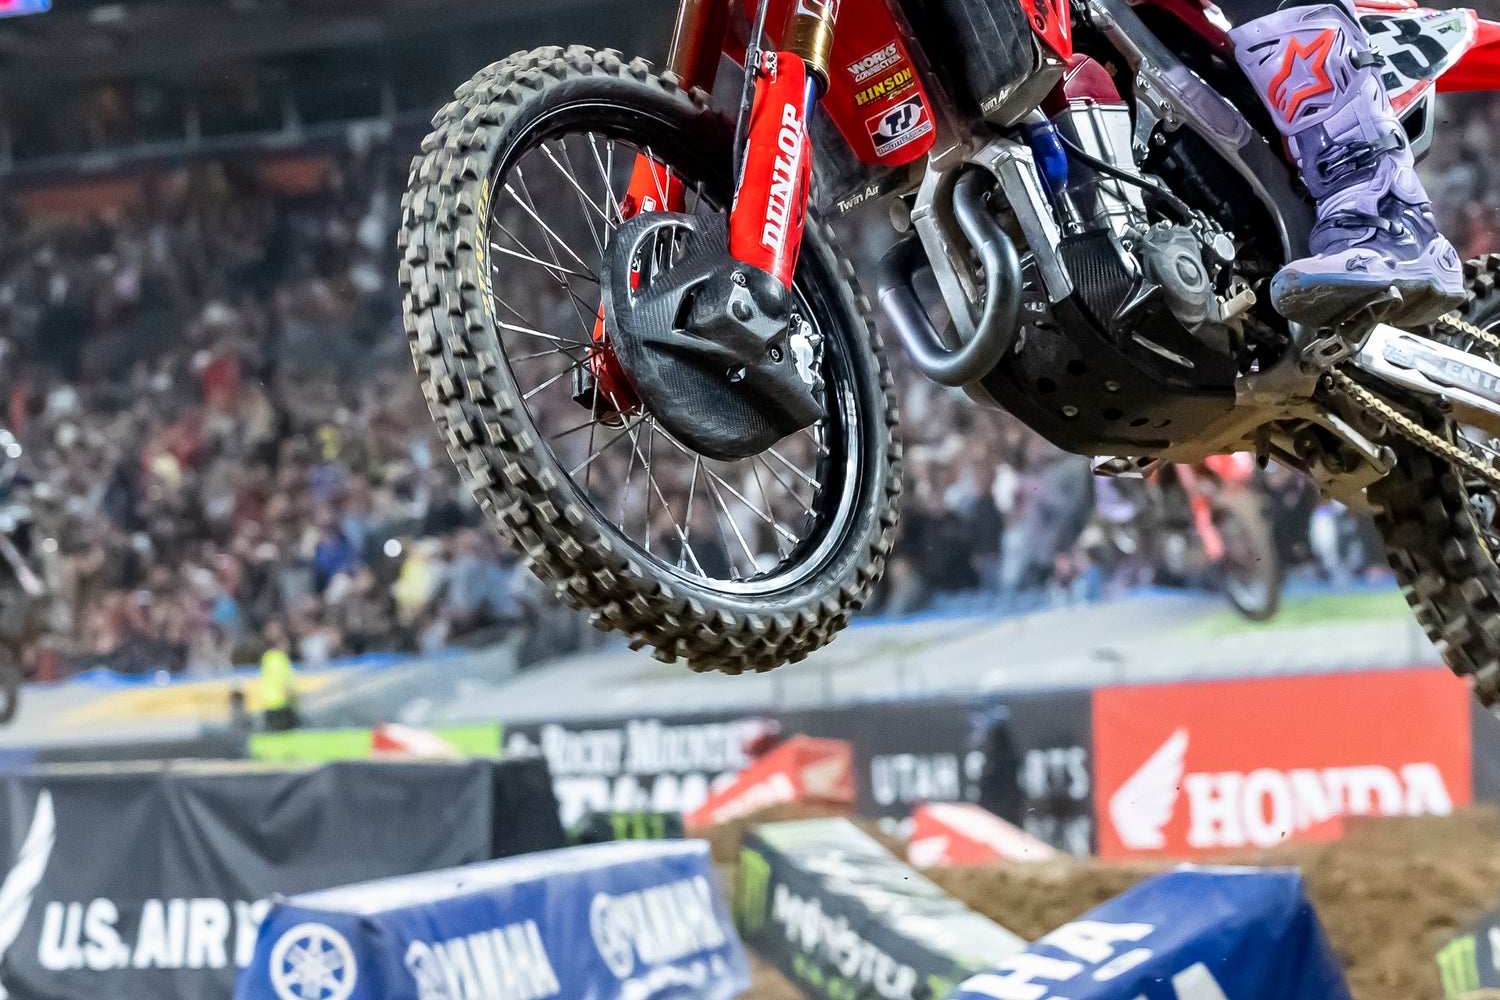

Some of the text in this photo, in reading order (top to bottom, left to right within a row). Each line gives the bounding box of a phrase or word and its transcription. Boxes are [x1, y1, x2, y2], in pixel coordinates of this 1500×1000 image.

[847, 42, 897, 75] WORKS
[854, 67, 913, 106] HINSON
[1359, 14, 1449, 92] 3
[761, 103, 803, 252] DUNLOP
[837, 184, 881, 214] Twin Air
[1185, 762, 1455, 849] HONDA
[133, 896, 231, 970] AIR
